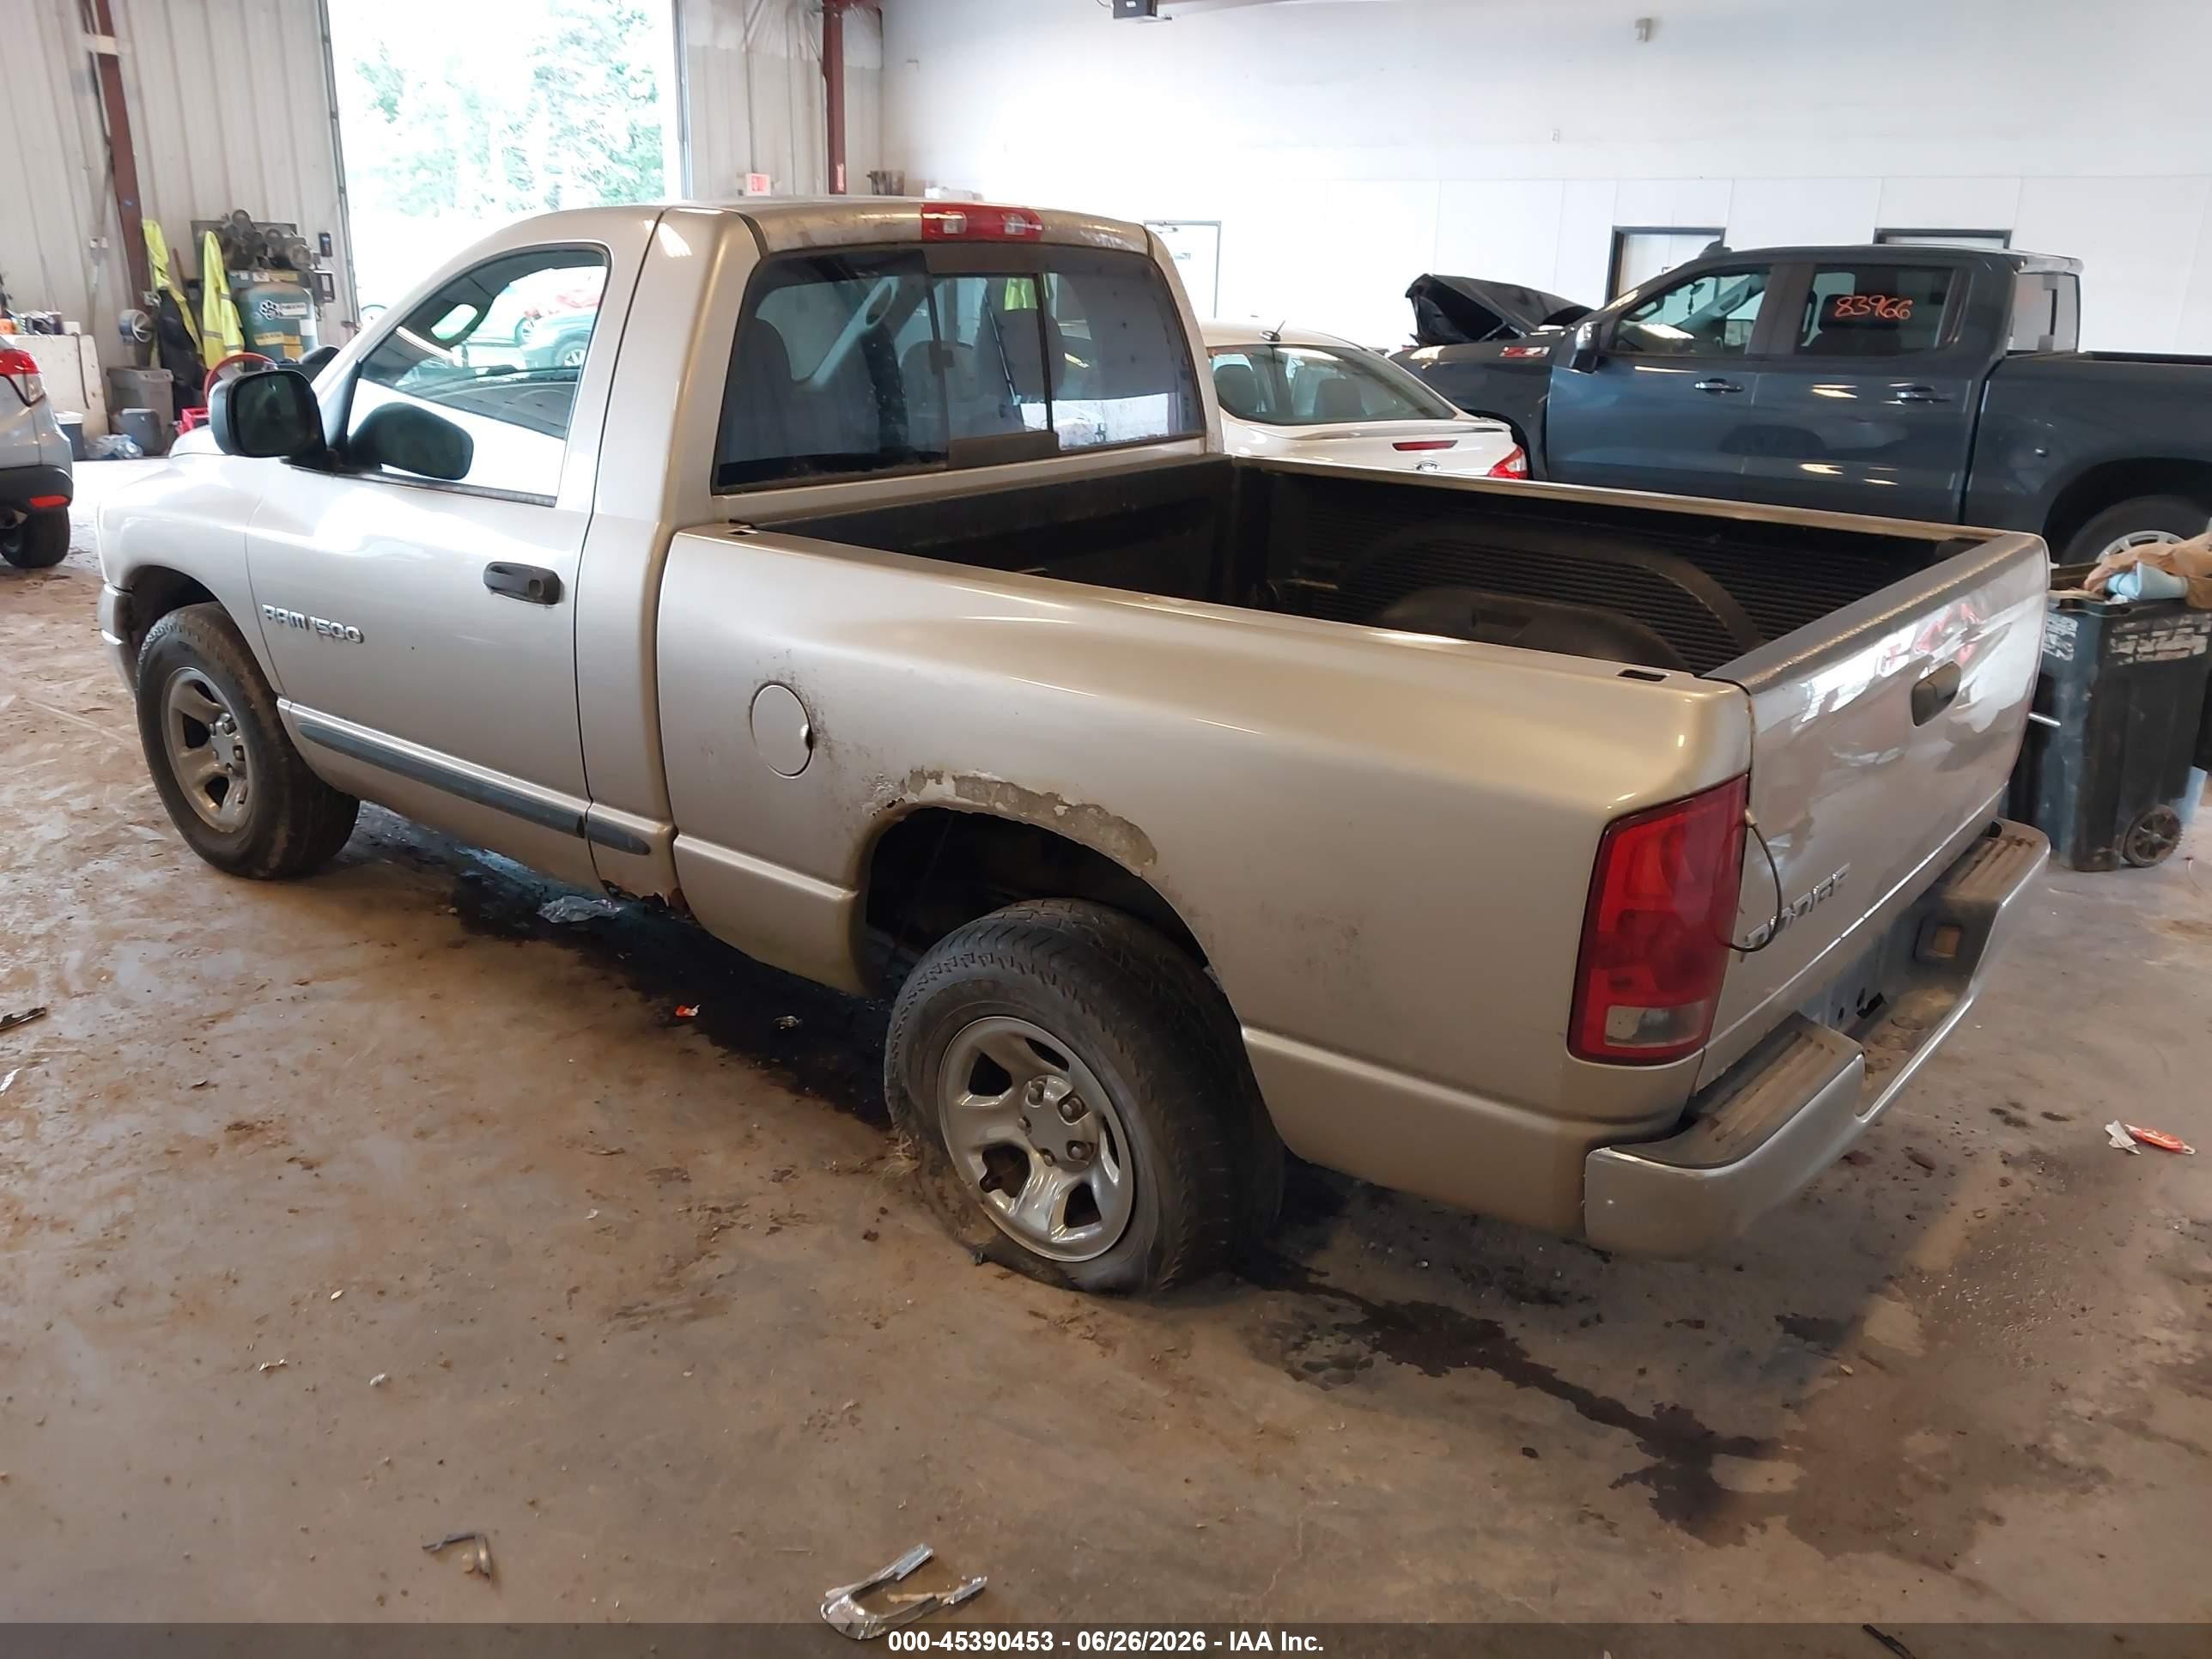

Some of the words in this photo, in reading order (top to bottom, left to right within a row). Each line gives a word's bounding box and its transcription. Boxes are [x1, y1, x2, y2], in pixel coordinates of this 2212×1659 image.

[1834, 295, 1913, 319] 83966
[261, 603, 308, 630] RAM
[309, 616, 364, 644] 1500
